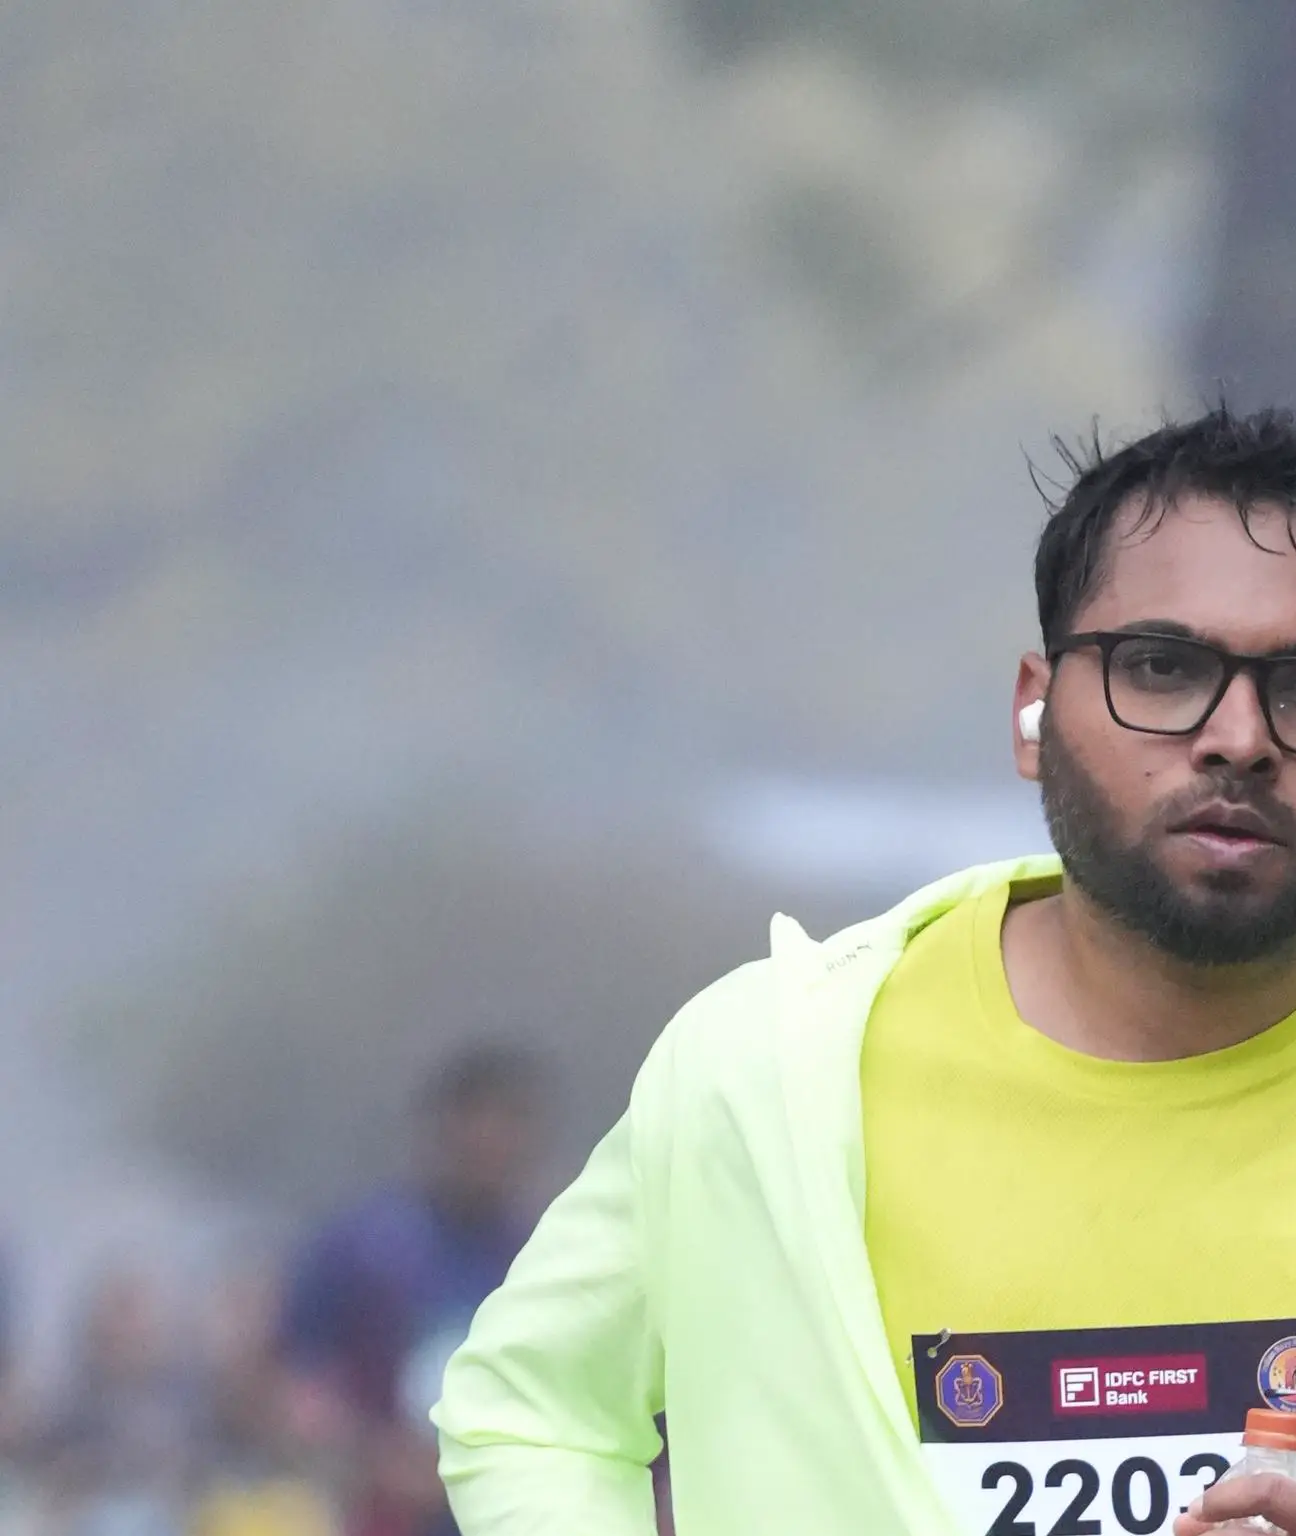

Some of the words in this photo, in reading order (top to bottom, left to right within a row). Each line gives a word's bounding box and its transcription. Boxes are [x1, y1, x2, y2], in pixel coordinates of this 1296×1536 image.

[1105, 1371, 1145, 1387] IDFC
[1149, 1369, 1198, 1385] FIRST
[1106, 1390, 1148, 1405] Bank
